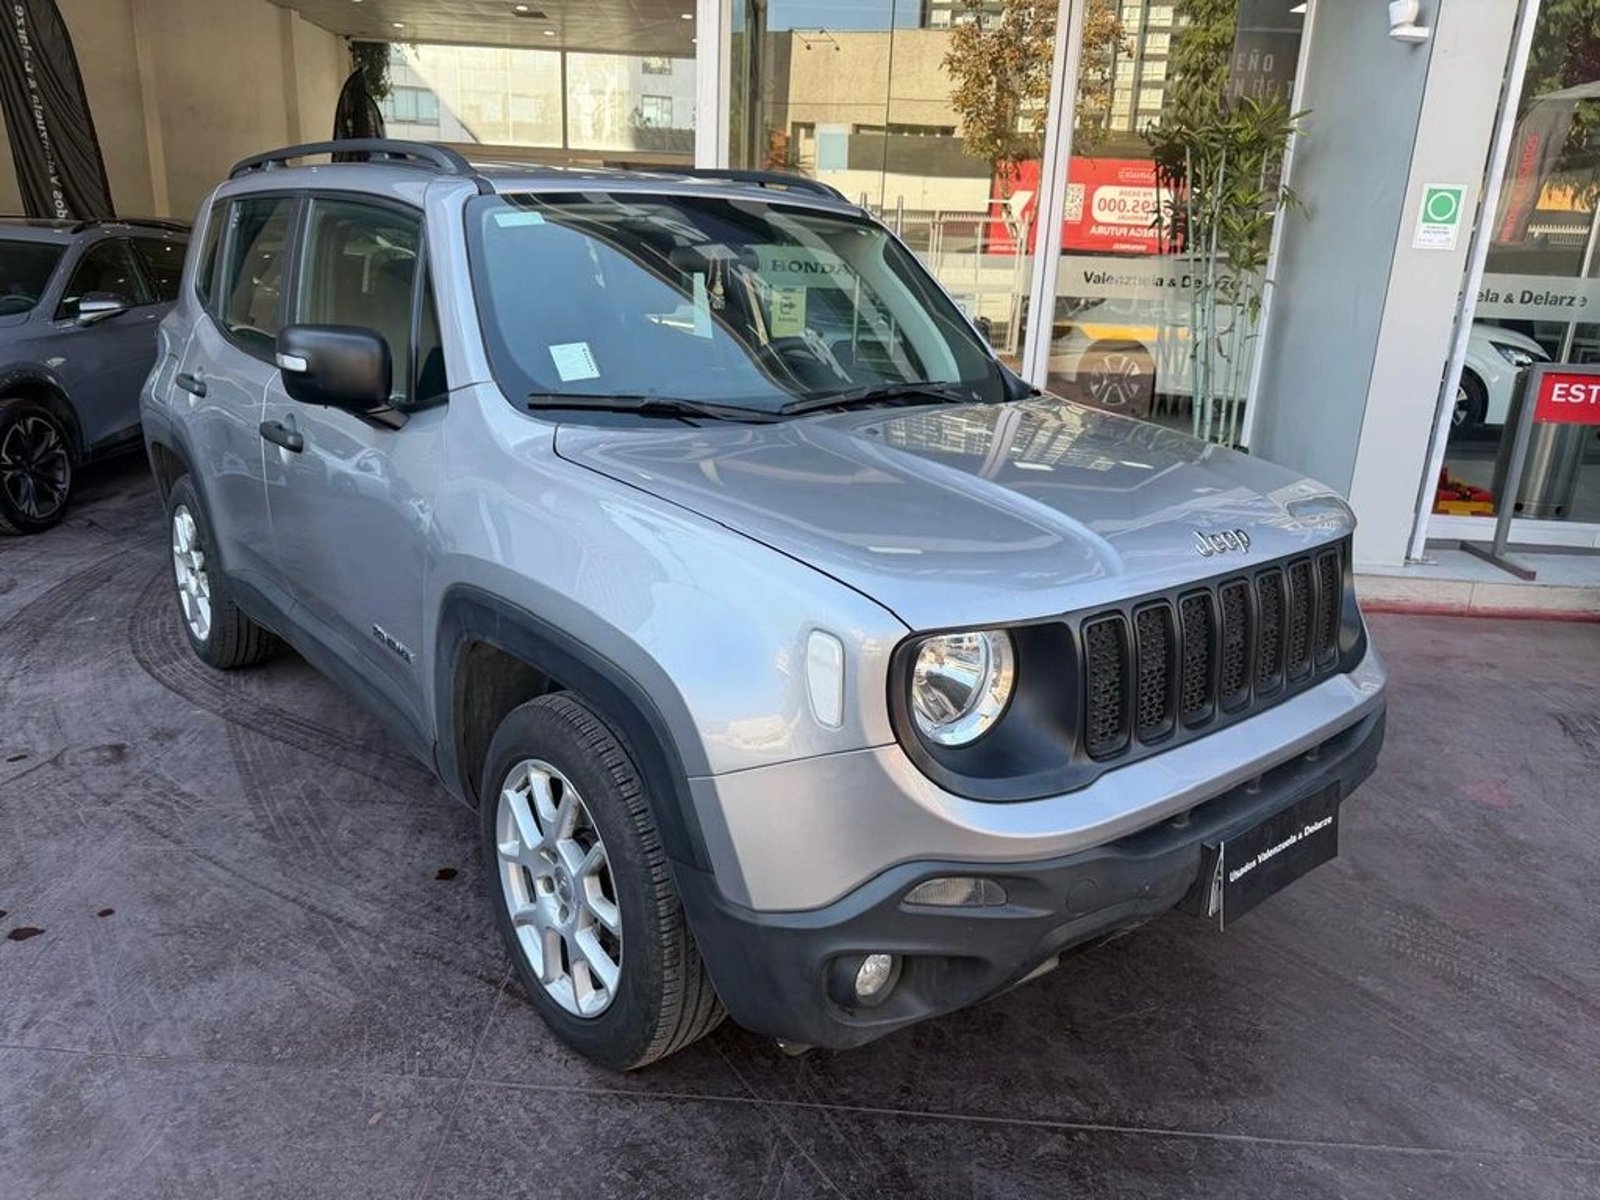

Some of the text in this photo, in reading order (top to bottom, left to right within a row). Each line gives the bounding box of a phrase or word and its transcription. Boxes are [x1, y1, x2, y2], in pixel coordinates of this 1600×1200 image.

[771, 259, 854, 276] HONDA
[1167, 279, 1177, 288] &
[1503, 292, 1514, 304] &
[1551, 383, 1600, 405] EST
[1192, 529, 1251, 557] Jeep
[1230, 860, 1257, 882] Usados
[1257, 834, 1298, 863] Valenzuela
[1303, 815, 1333, 837] Delarze
